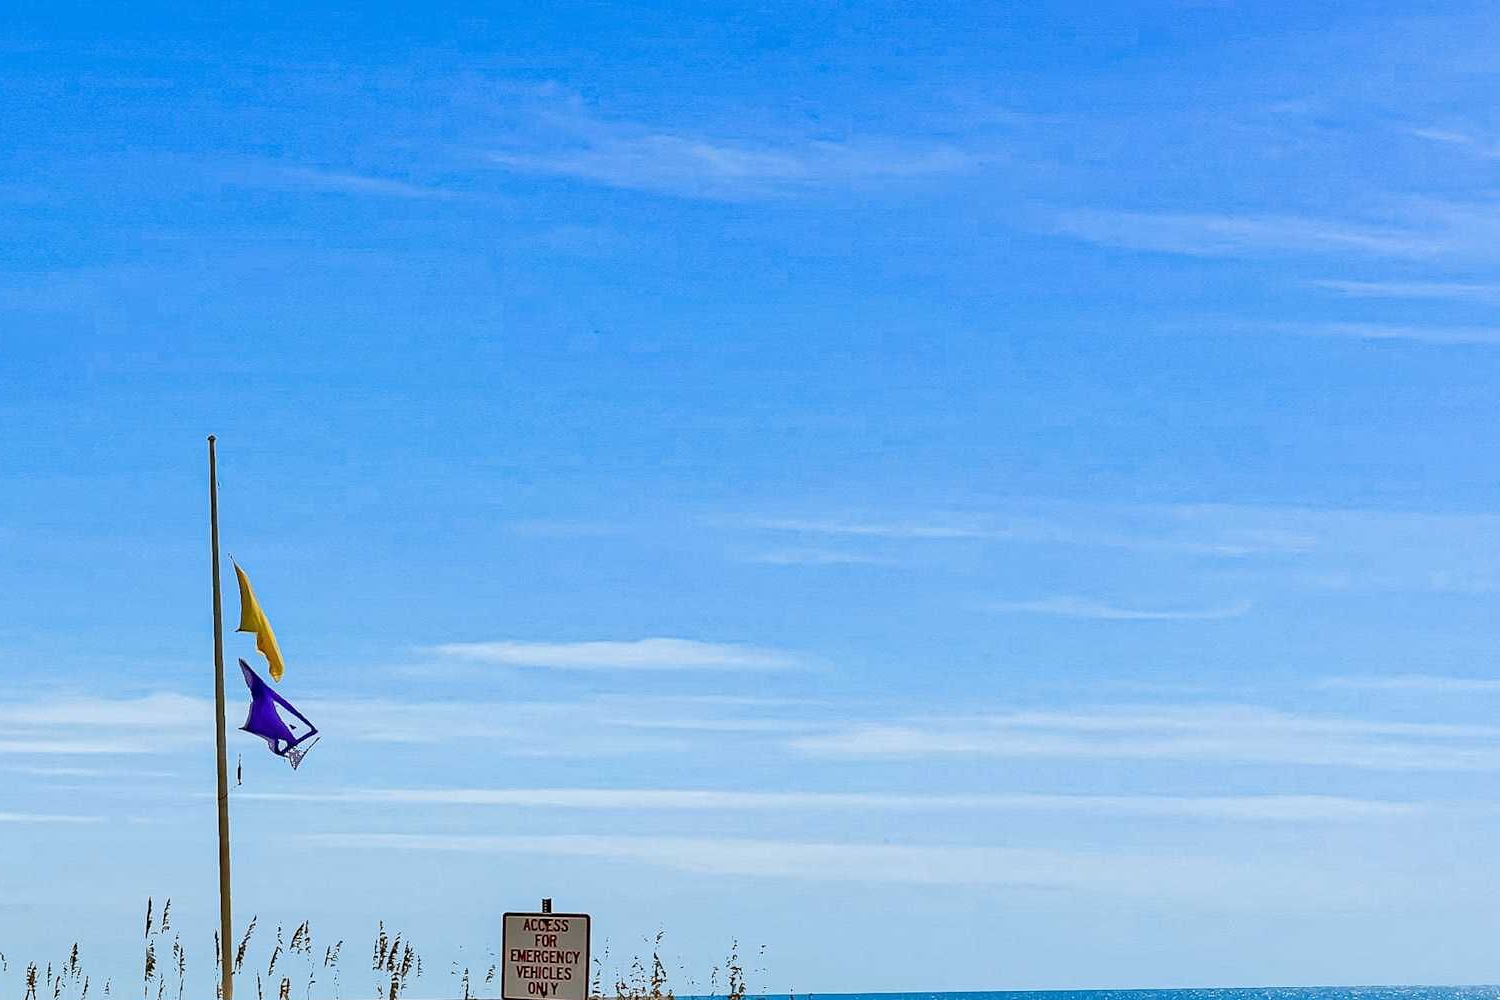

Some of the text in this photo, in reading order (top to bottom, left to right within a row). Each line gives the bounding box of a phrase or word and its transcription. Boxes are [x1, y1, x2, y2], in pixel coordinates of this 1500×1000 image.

[523, 918, 569, 932] ACCESS
[535, 934, 557, 947] FOR
[510, 949, 580, 964] EMERGENCY
[516, 966, 572, 980] VEHICLES
[528, 982, 558, 995] ONLY
